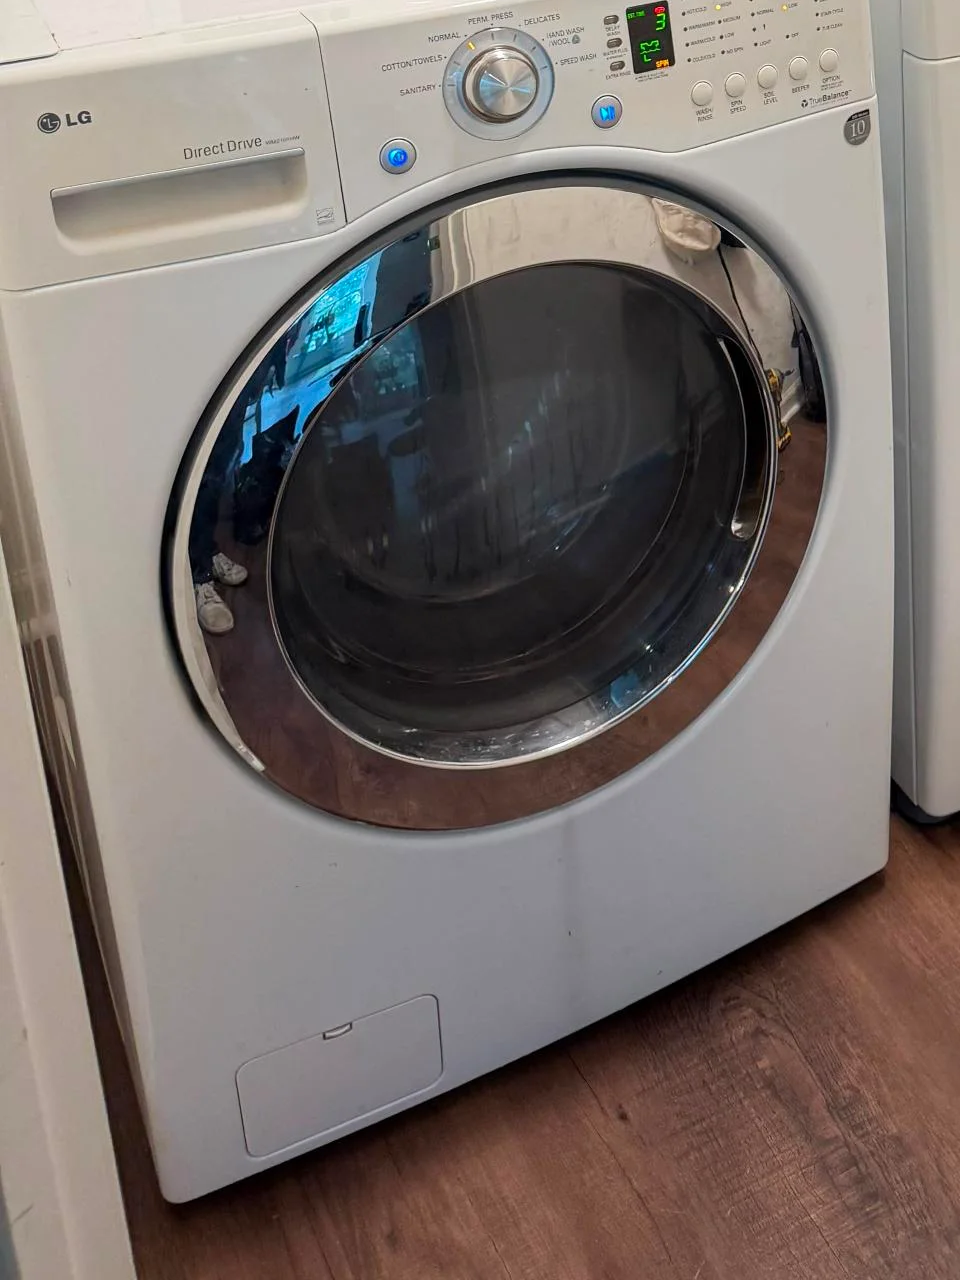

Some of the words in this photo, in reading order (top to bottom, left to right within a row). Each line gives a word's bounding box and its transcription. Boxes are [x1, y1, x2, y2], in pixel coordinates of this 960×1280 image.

[491, 11, 514, 22] PRESS
[524, 13, 560, 26] DELICATES
[656, 13, 666, 31] 3
[428, 32, 461, 43] NORMAL
[546, 28, 564, 38] HAND
[565, 26, 585, 36] WASH
[381, 54, 443, 72] COTTON/TOWELS
[560, 56, 576, 66] SPEED
[576, 53, 597, 63] WASH
[822, 75, 841, 84] OPTION
[399, 83, 437, 96] SANITARY
[791, 84, 810, 94] BEEPER
[763, 91, 775, 99] SOIL
[731, 99, 743, 107] SPIN
[763, 97, 778, 105] LEVEL
[730, 105, 747, 114] SPEED
[65, 110, 92, 127] LG
[697, 114, 713, 123] RINSE
[851, 119, 866, 138] 10
[183, 143, 225, 160] Direct
[227, 135, 262, 152] Drive
